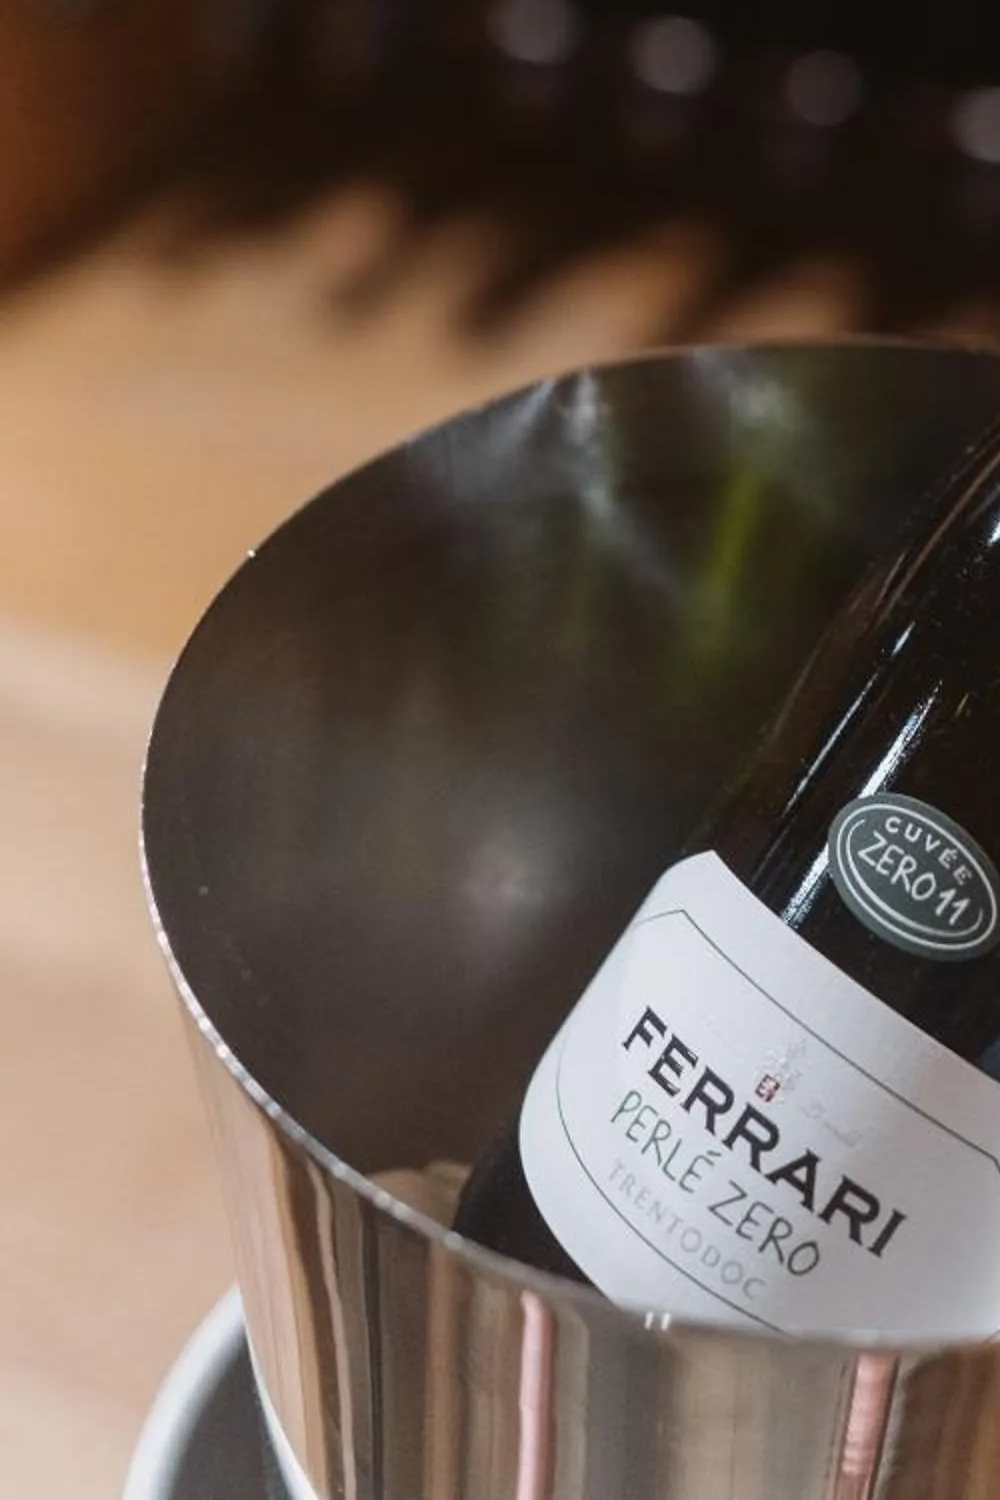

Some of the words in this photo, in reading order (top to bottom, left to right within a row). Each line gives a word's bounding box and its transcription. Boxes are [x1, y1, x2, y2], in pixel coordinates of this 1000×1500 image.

[884, 815, 973, 886] CUVÉE
[610, 1090, 722, 1194] PERLÉ
[707, 1180, 820, 1277] ZERO
[621, 1005, 908, 1259] FERRARI
[606, 1158, 767, 1300] TRENTODOC
